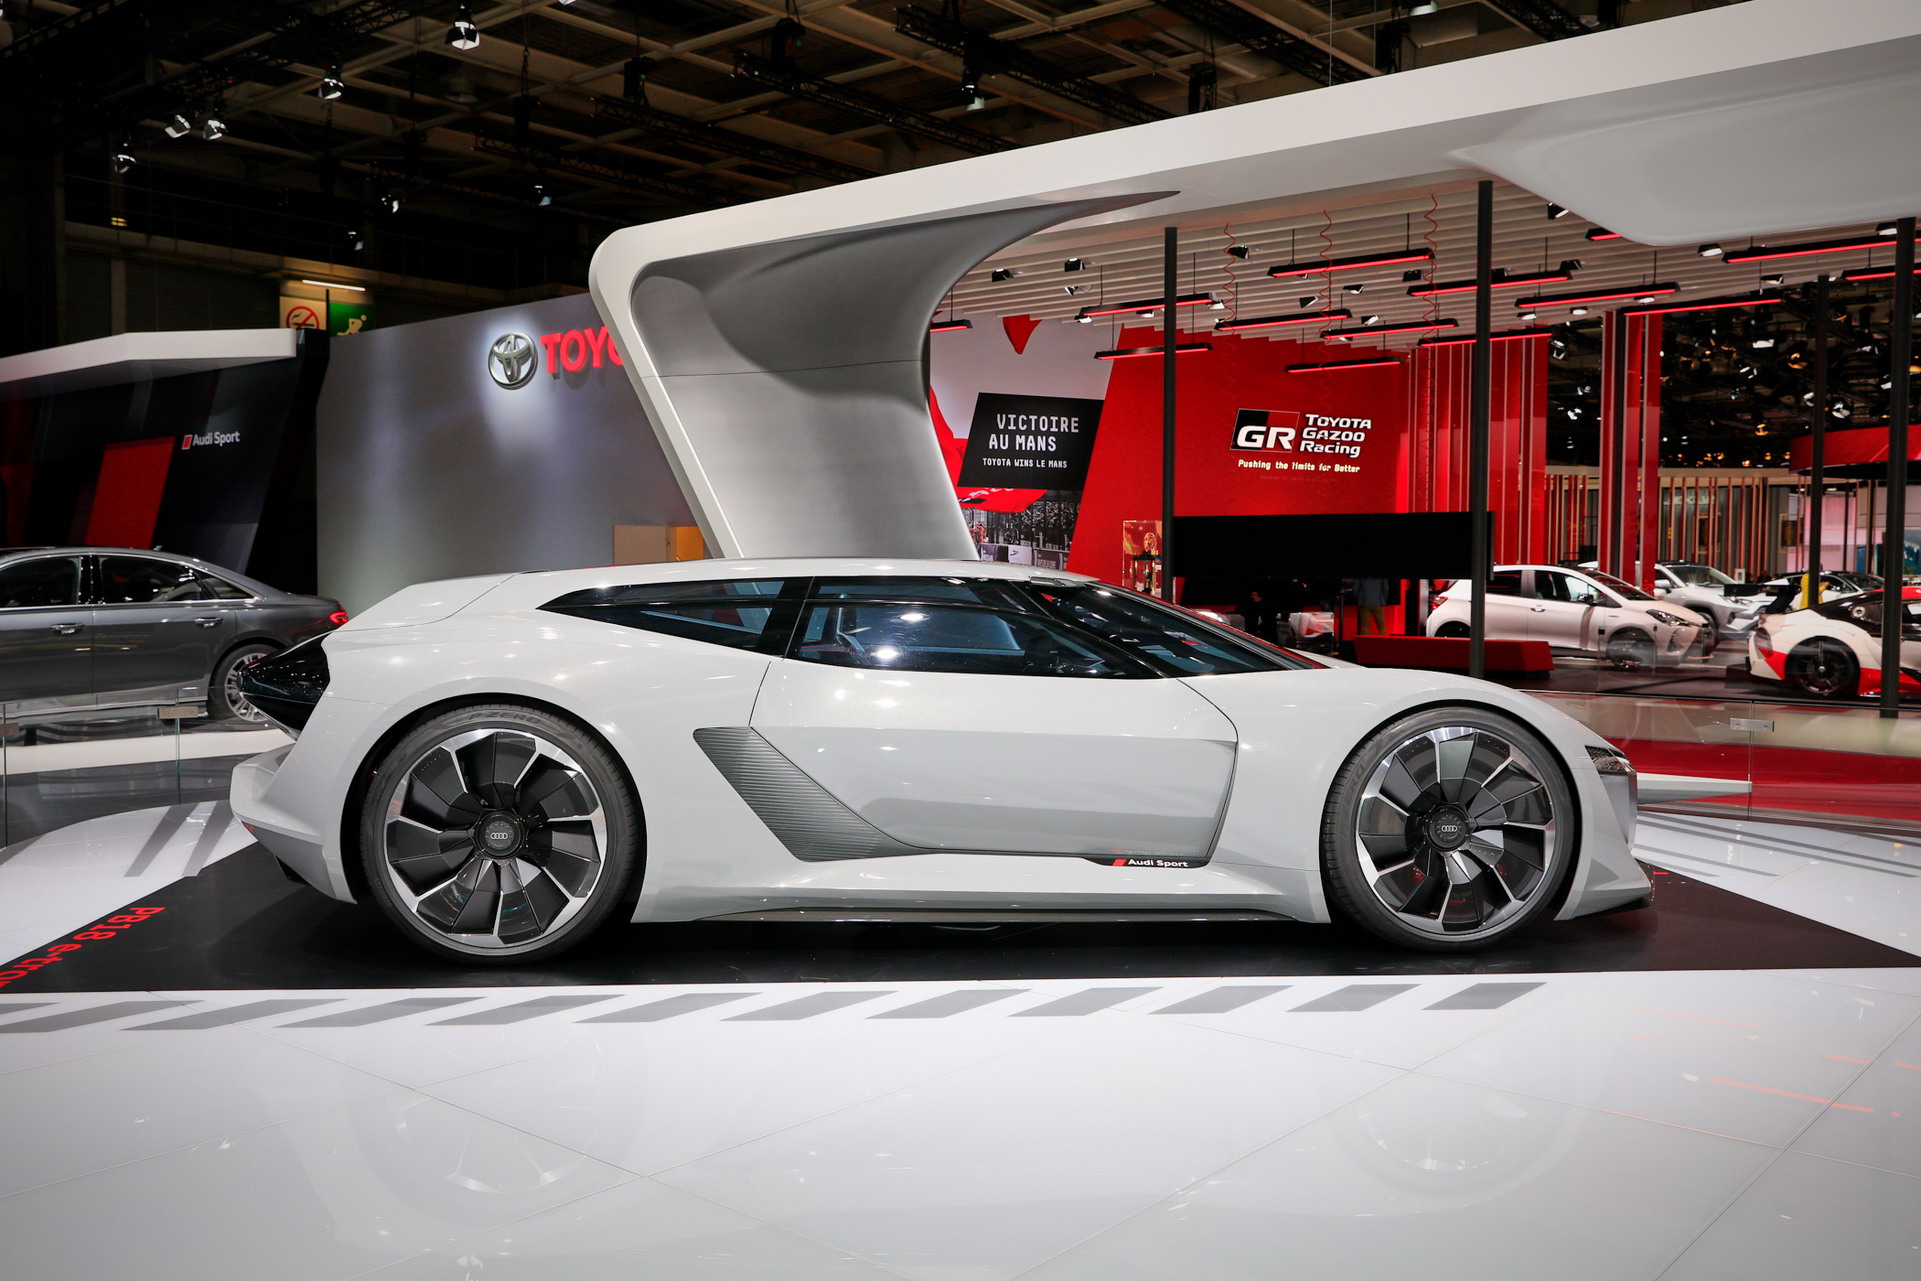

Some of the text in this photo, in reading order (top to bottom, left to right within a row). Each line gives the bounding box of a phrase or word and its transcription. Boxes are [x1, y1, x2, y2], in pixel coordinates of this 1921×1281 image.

[996, 413, 1079, 433] VICTOIRE
[1305, 413, 1372, 429] TOYOTA
[192, 431, 240, 447] Audi Sport
[988, 433, 1057, 452] AU MANS
[1236, 425, 1296, 450] GR
[1302, 427, 1365, 442] GAZOO
[1299, 440, 1361, 458] Racing
[982, 457, 1068, 469] TOYOTA WINS LE MANS
[1238, 459, 1361, 473] Pushing the limits for Better
[1156, 859, 1188, 868] Sport
[73, 907, 166, 941] PB18
